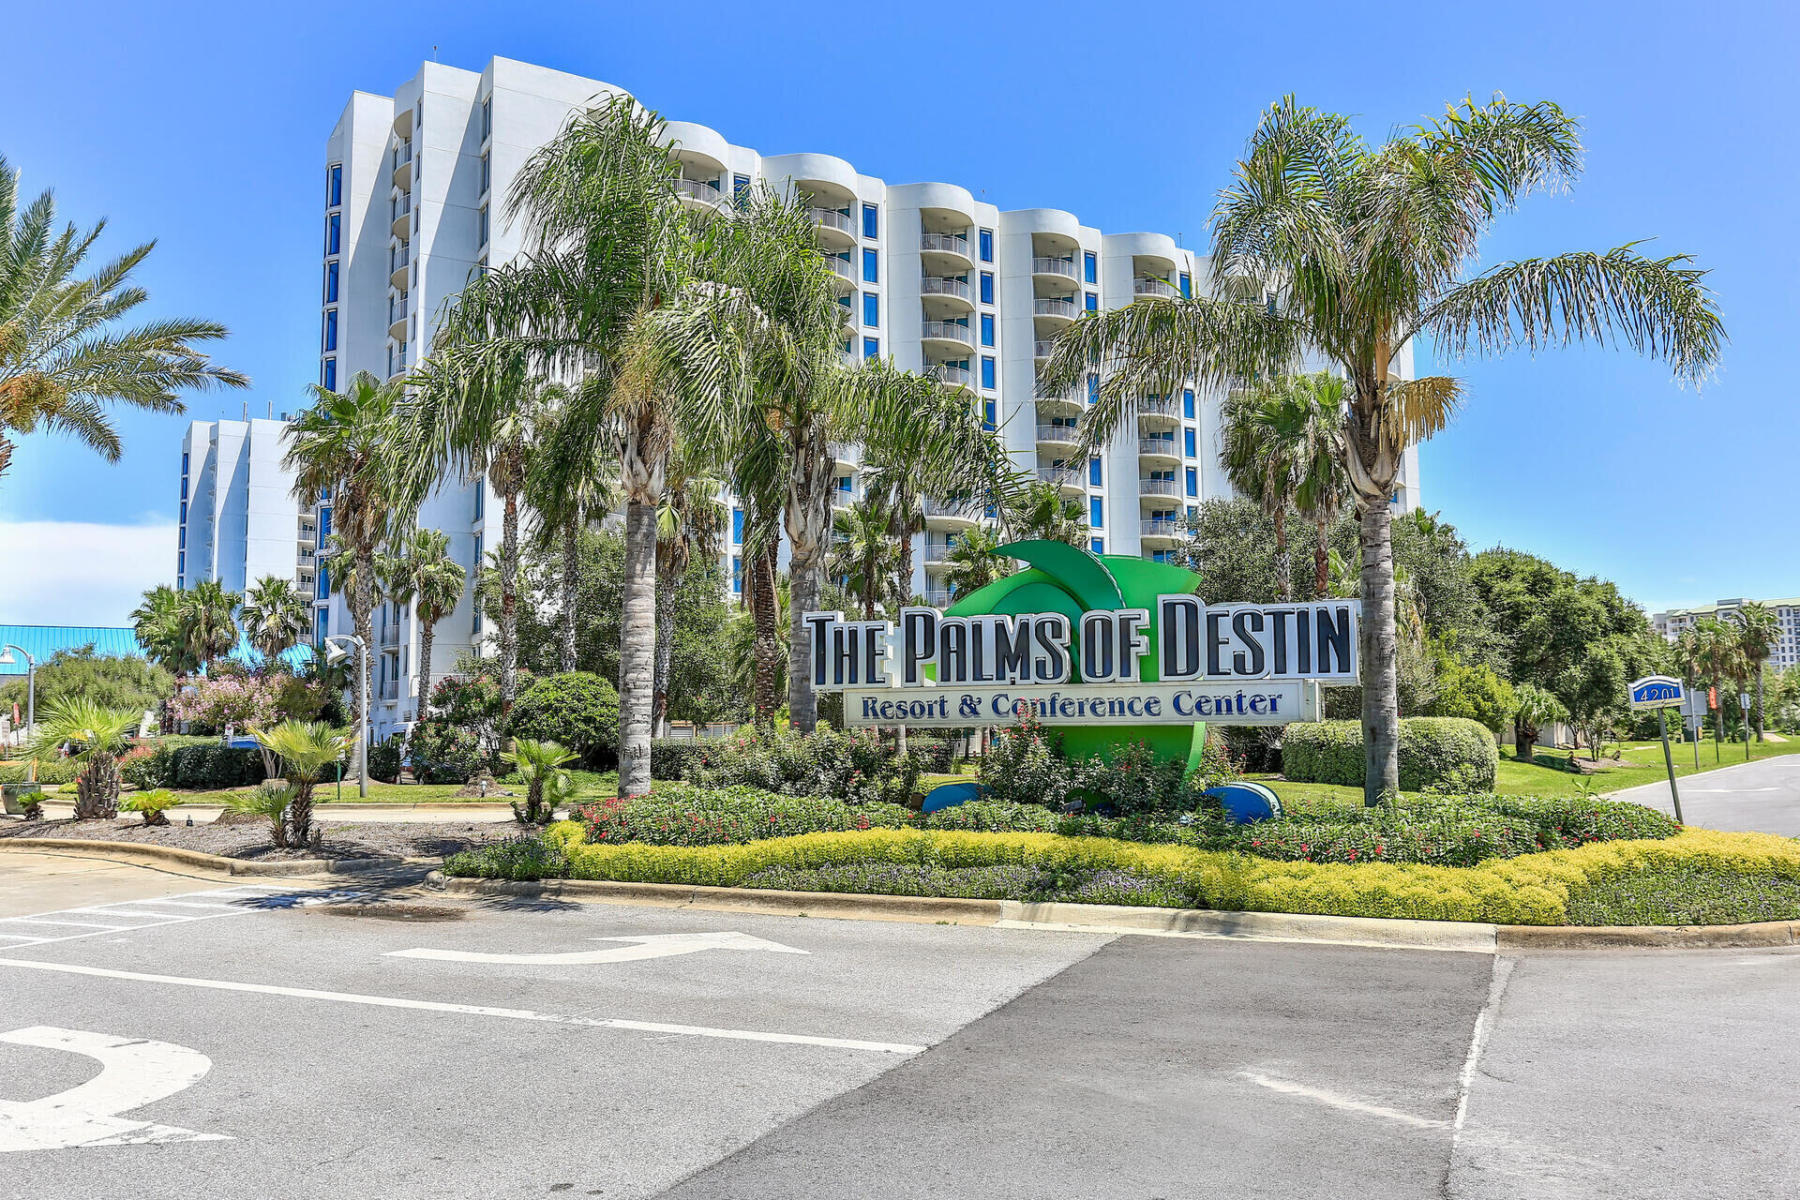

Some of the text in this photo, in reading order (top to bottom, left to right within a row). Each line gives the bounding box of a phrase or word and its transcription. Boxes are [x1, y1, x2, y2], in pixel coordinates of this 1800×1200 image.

[805, 598, 1352, 686] THE PALMS OF DESTIN
[862, 695, 950, 719] Resort
[959, 694, 982, 718] &
[1173, 690, 1283, 716] Center
[1641, 688, 1675, 701] 4201
